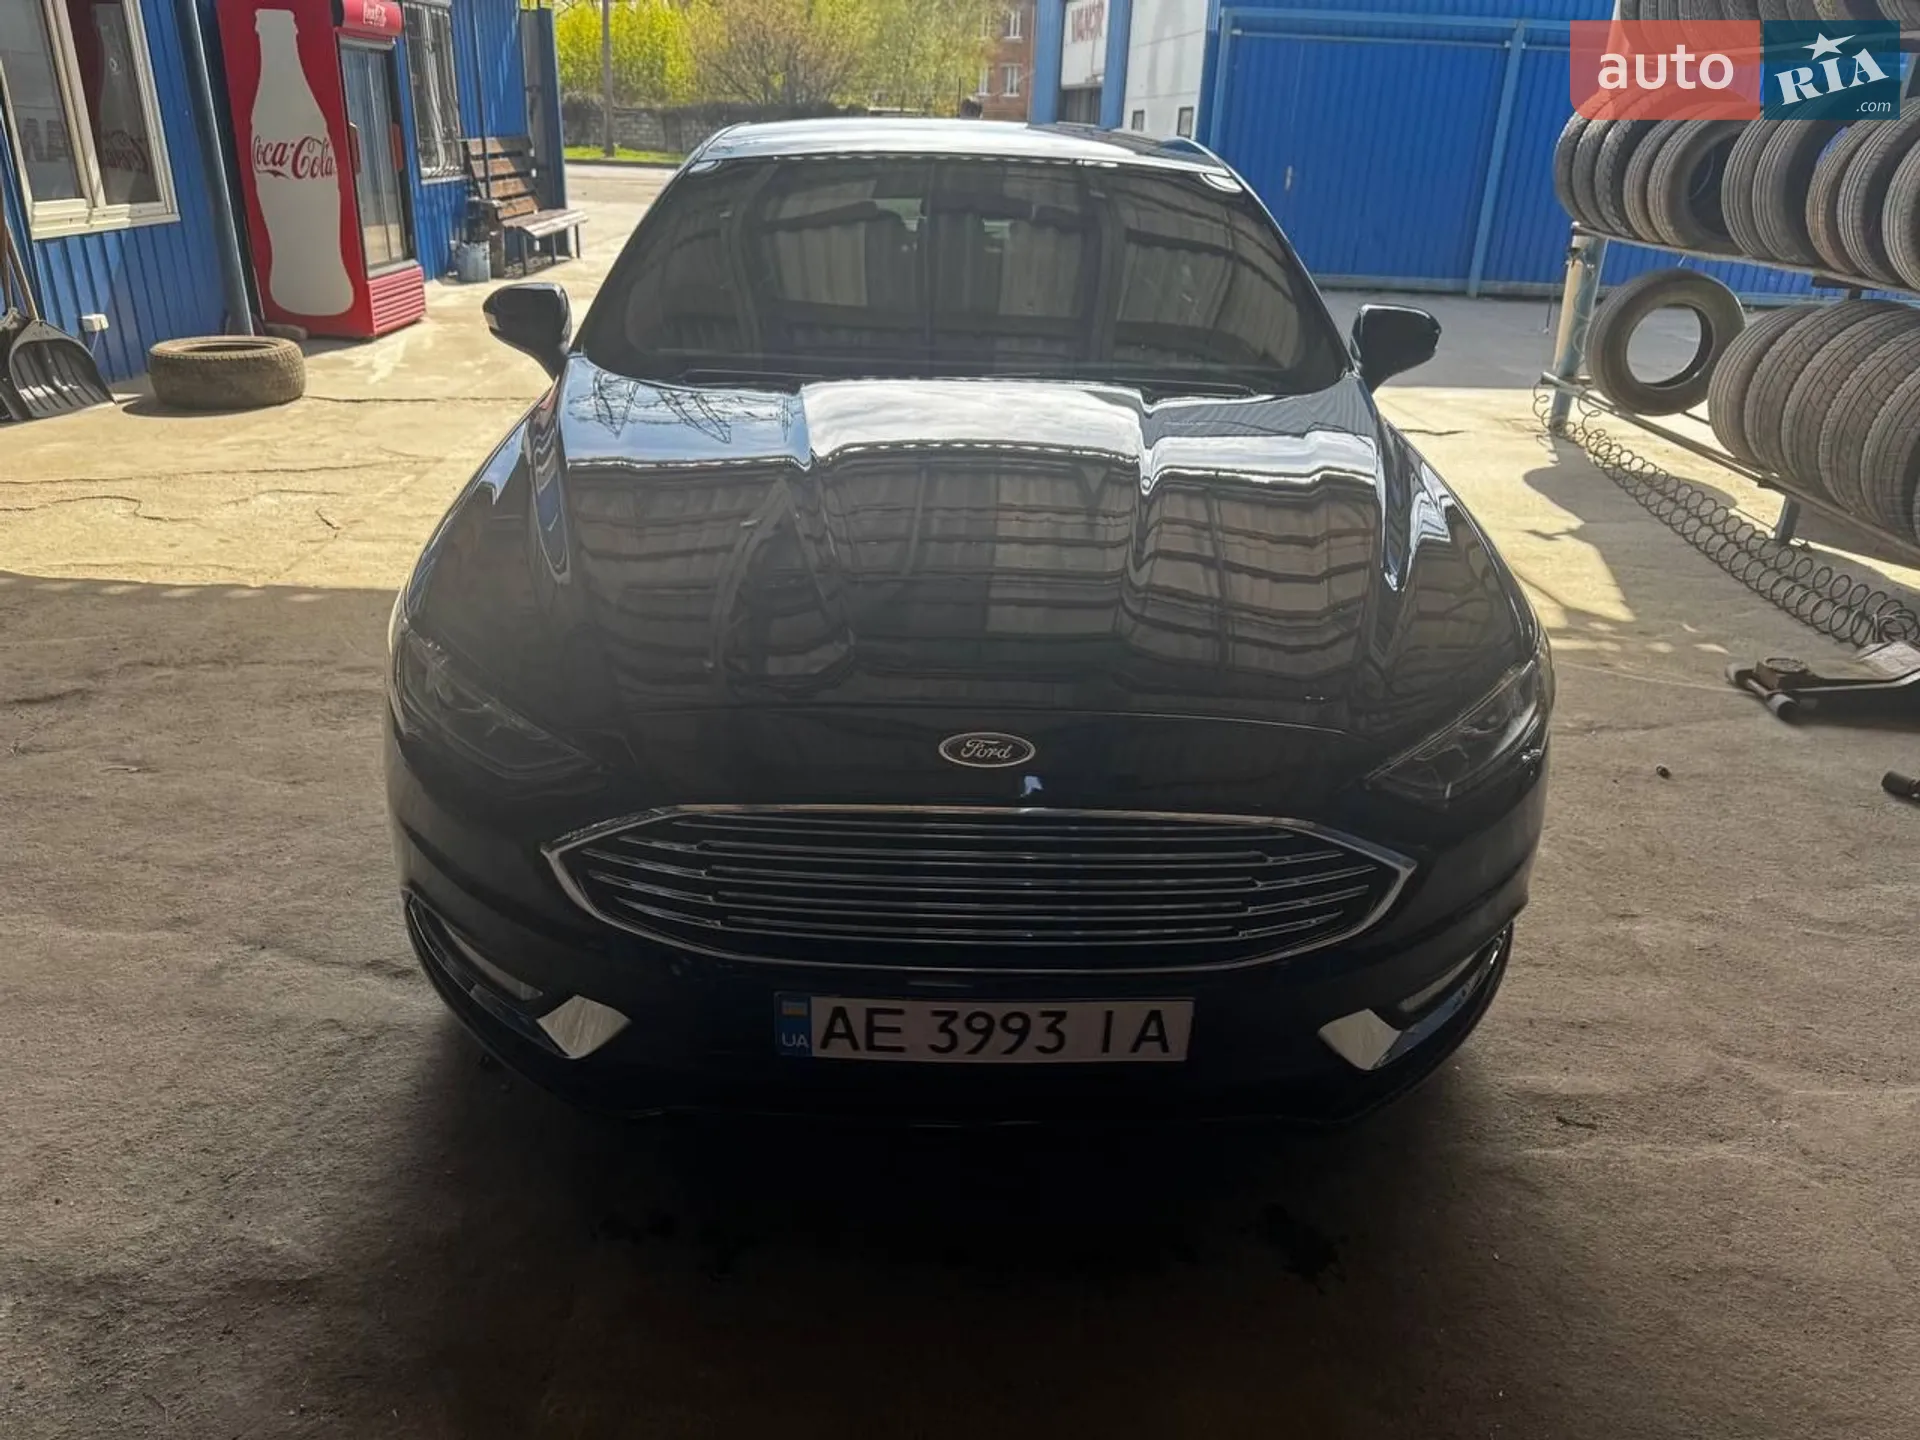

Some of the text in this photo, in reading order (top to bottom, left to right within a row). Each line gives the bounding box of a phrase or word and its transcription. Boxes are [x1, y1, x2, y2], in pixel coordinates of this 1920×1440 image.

[960, 739, 1014, 759] Ford
[819, 1006, 1170, 1055] AE 3993 IA
[781, 1033, 810, 1049] UA
